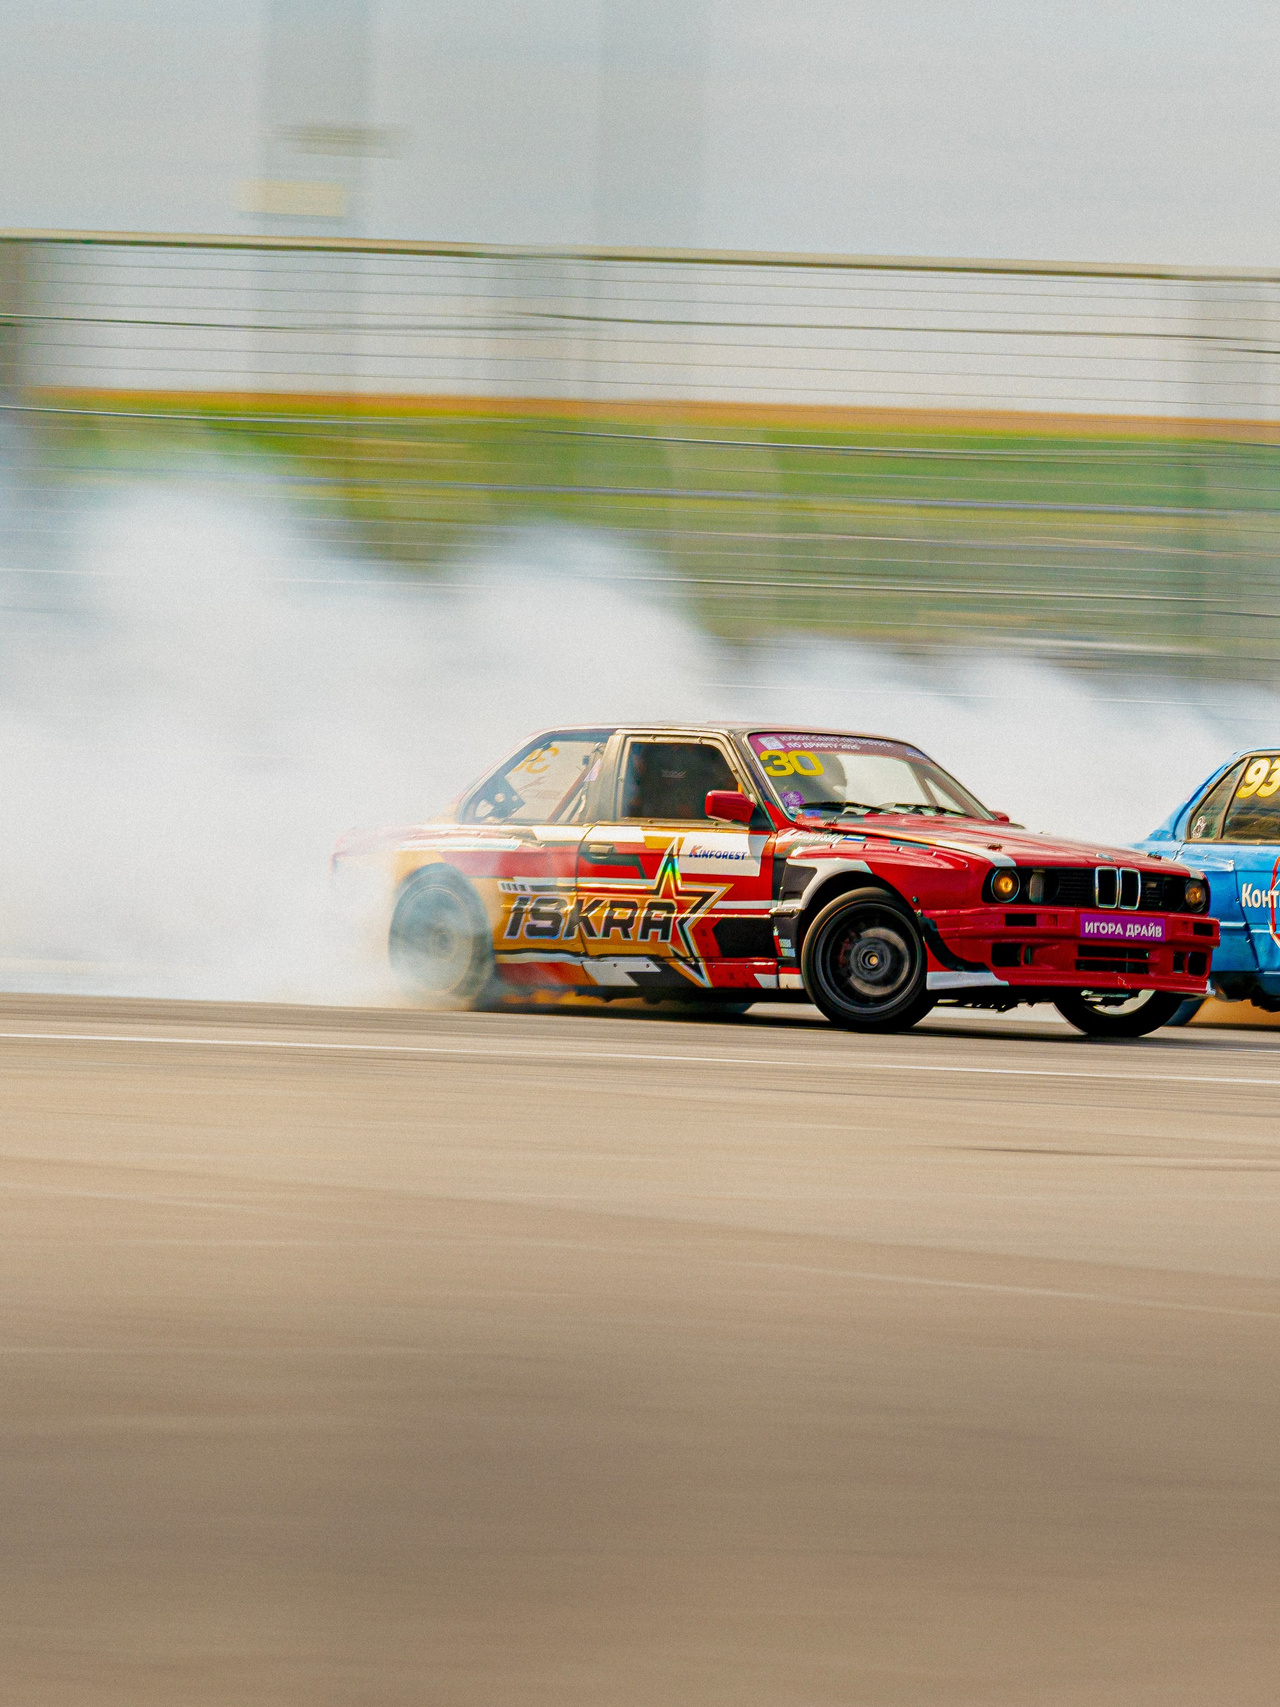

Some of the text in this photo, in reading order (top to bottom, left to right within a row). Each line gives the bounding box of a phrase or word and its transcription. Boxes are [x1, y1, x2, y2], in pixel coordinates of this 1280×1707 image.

[759, 750, 825, 777] 30
[688, 845, 747, 861] KINFOREST
[503, 896, 678, 943] ISKRA
[1085, 921, 1163, 938] ИГОРА ДРАЙВ
